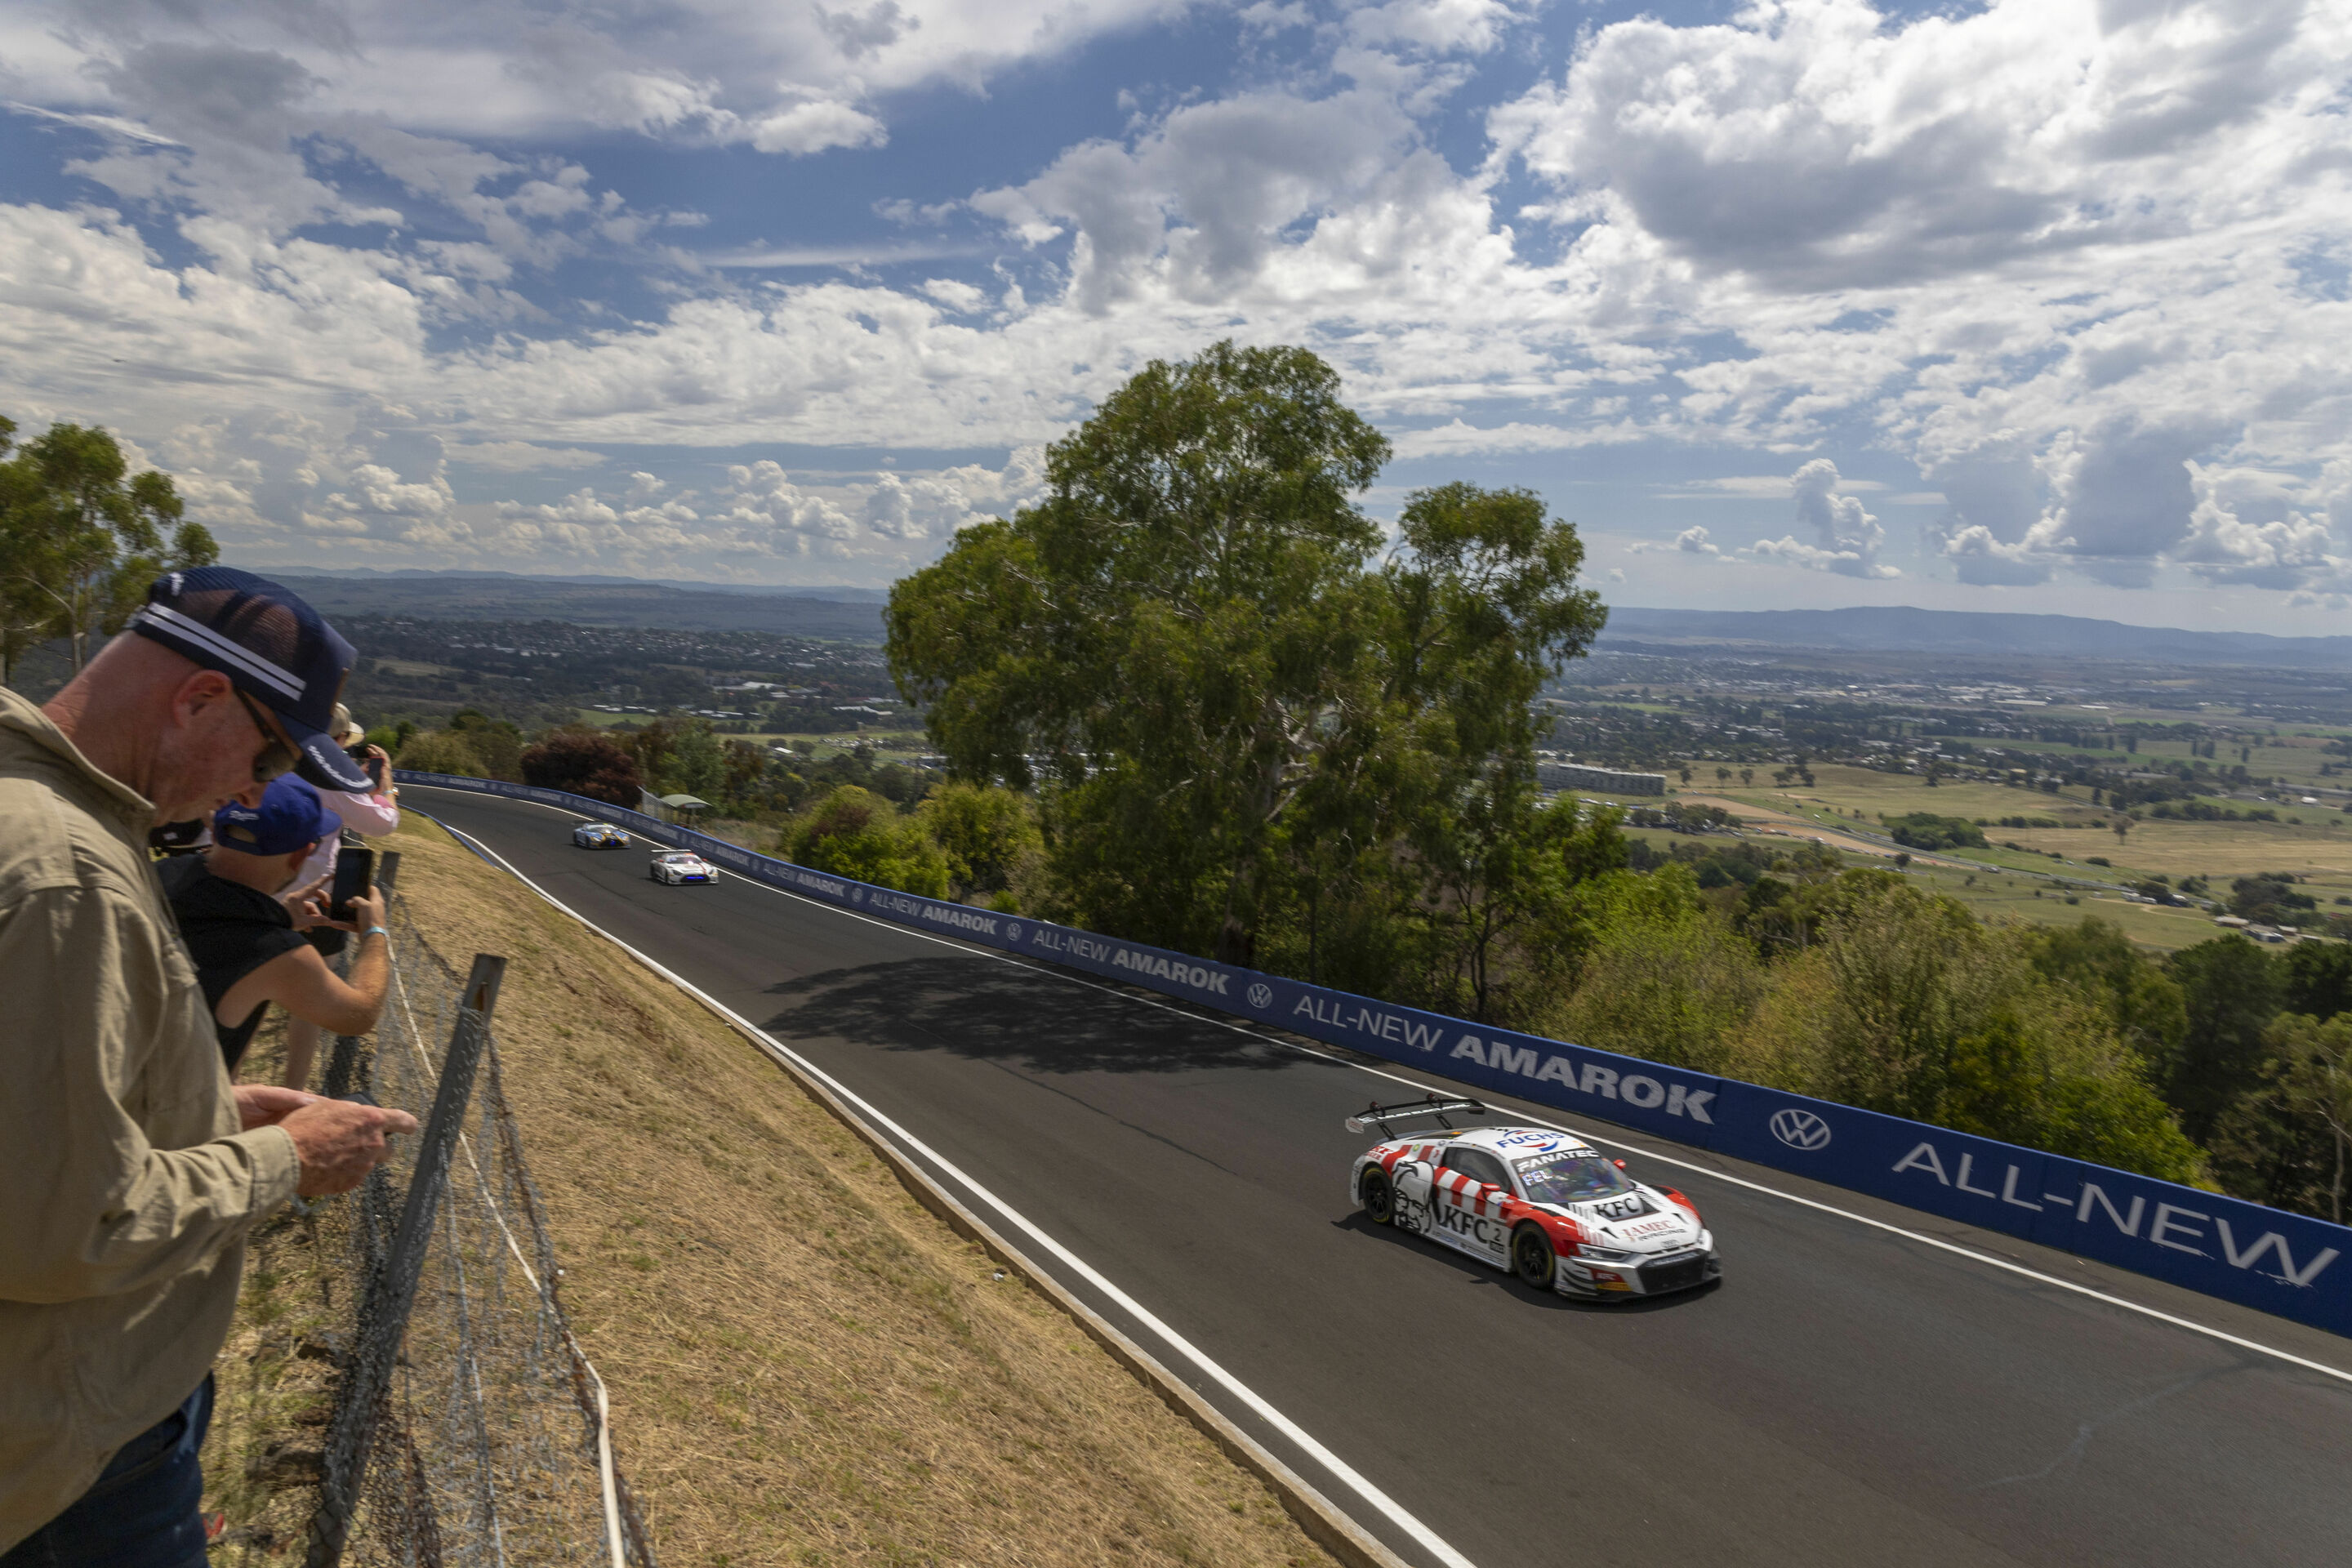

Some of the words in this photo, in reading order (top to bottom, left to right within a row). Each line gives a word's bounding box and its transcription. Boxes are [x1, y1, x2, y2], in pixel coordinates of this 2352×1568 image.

[868, 892, 923, 916] ALL-NEW
[921, 905, 998, 935] AMAROK
[1031, 929, 1111, 963] ALL-NEW
[1111, 948, 1231, 996] AMAROK
[1292, 995, 1444, 1053] ALL-NEW
[1449, 1035, 1717, 1125] AMAROK
[1495, 1132, 1566, 1148] FUCHS
[1517, 1150, 1601, 1174] FANATEC
[1521, 1169, 1553, 1187] FEL
[1593, 1197, 1639, 1218] KFC
[1891, 1142, 2341, 1288] ALL-NEW
[1440, 1204, 1489, 1244] KFC
[1493, 1227, 1503, 1241] 2
[1622, 1220, 1676, 1240] JAMEC
